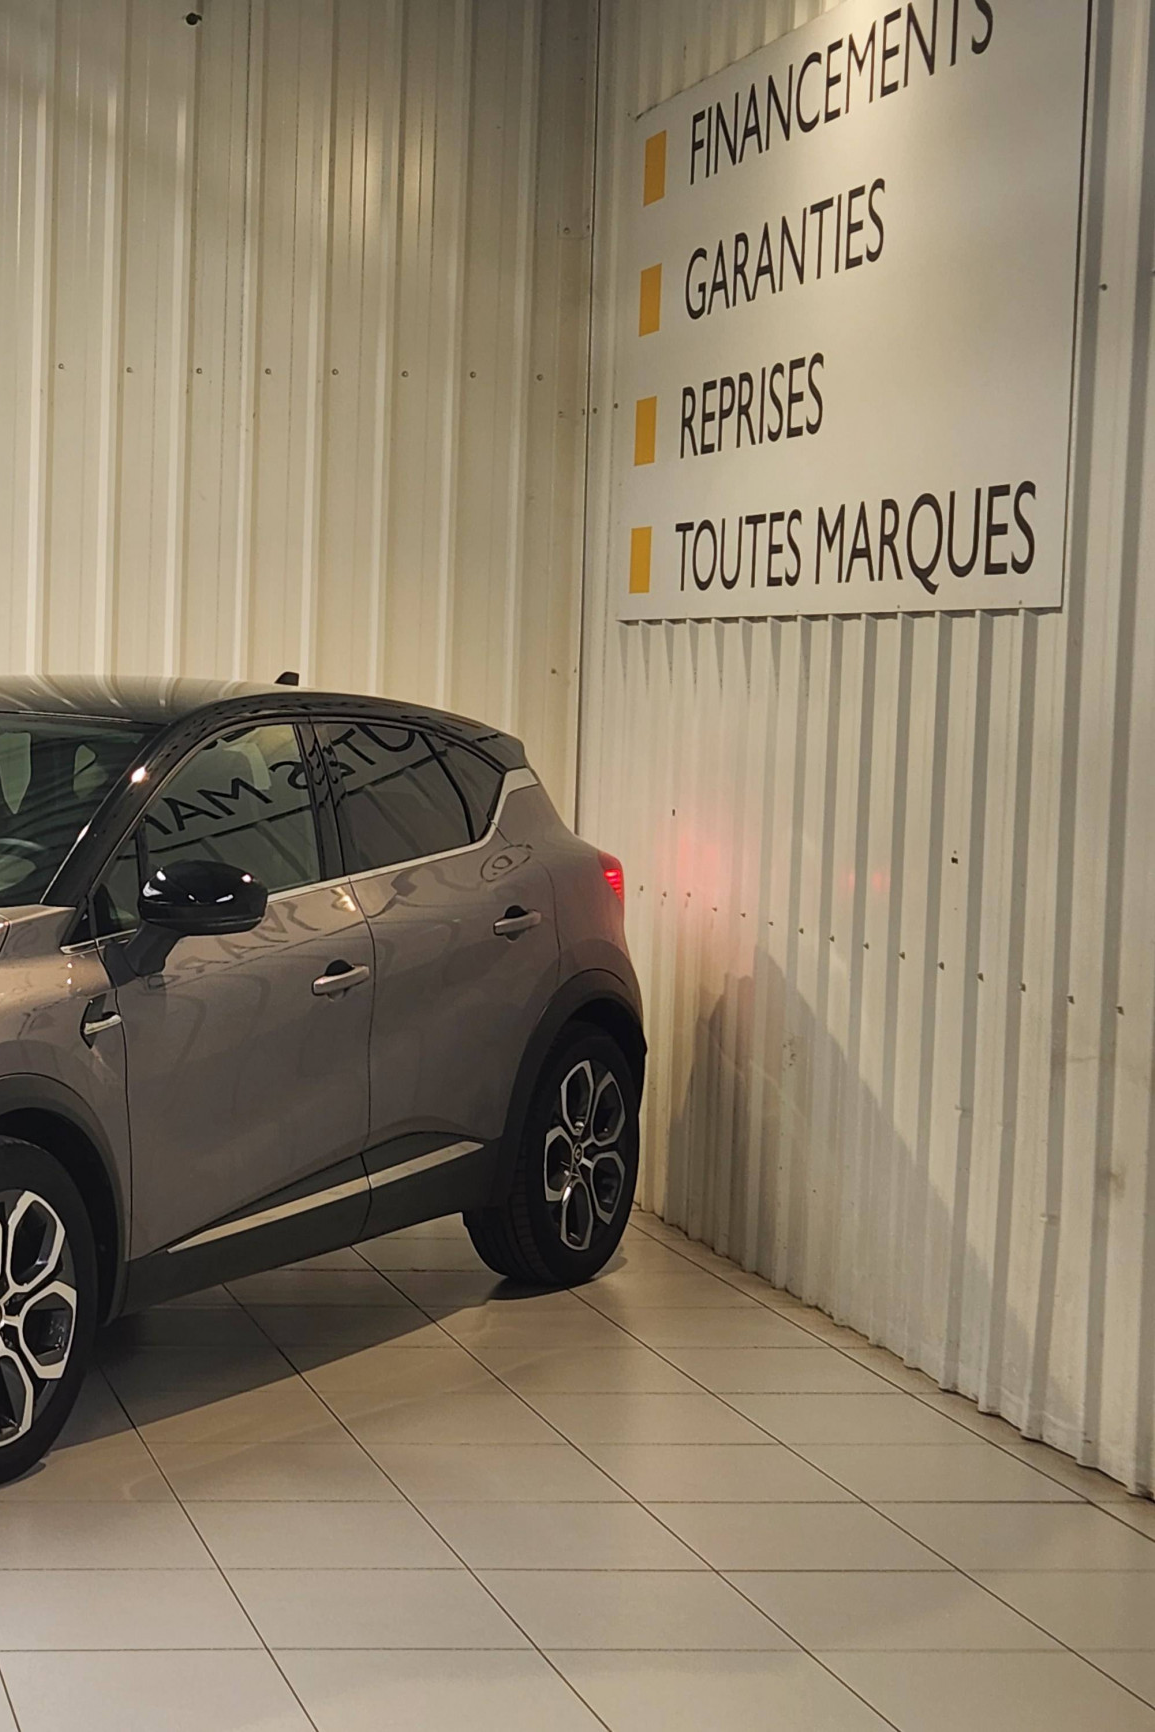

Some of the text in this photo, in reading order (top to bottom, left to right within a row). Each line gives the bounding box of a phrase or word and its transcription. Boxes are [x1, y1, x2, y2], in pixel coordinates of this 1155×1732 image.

[684, 177, 886, 321] GARANTIES
[679, 352, 825, 460] REPRISES
[675, 480, 1037, 596] TOUTES MARQUES
